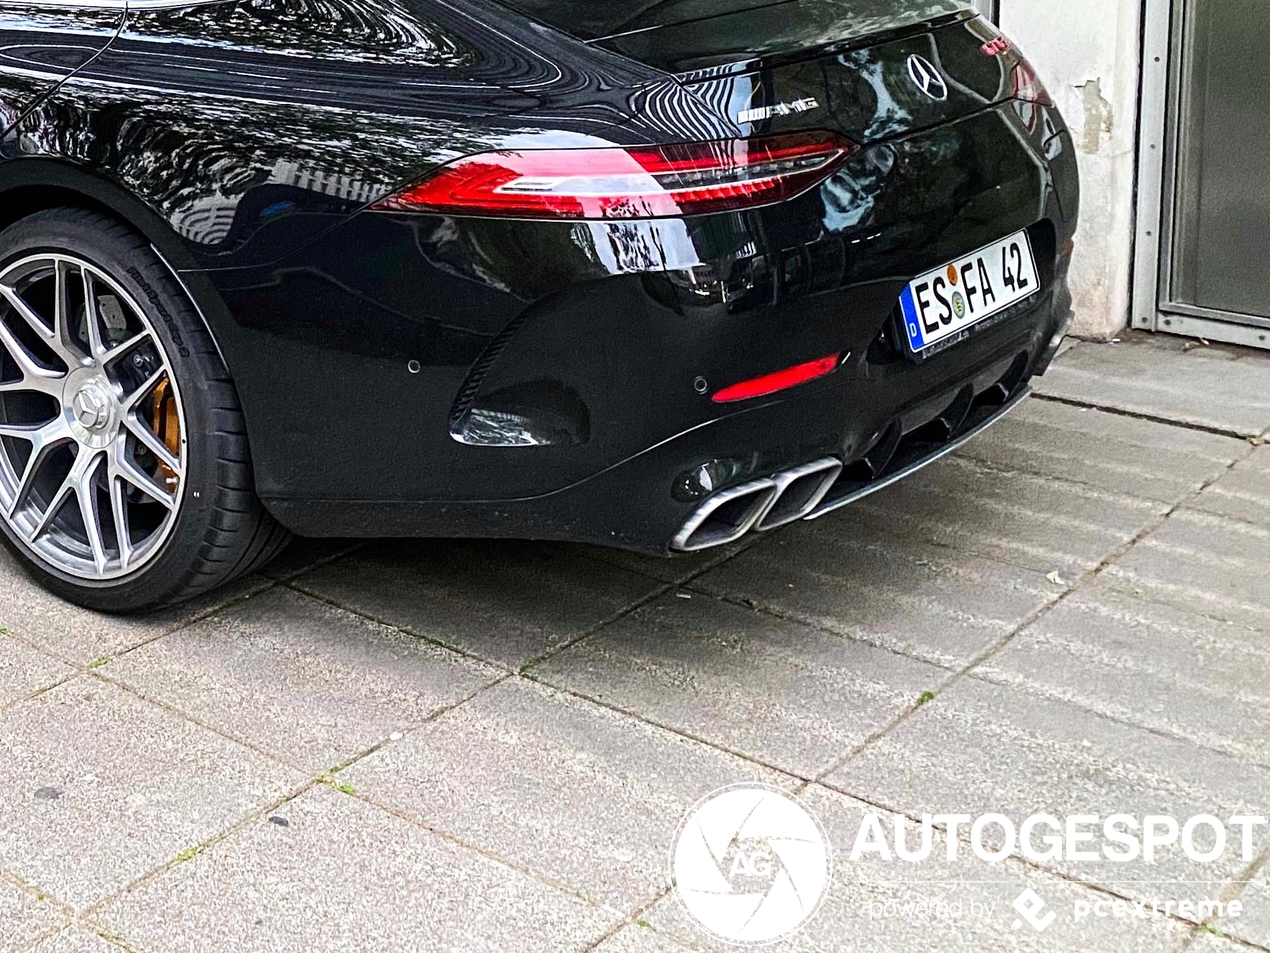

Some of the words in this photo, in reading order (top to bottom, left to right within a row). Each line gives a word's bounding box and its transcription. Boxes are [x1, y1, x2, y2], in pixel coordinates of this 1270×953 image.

[767, 97, 820, 118] AMG
[915, 276, 953, 335] ES
[961, 257, 996, 313] FA
[1002, 242, 1028, 292] 42
